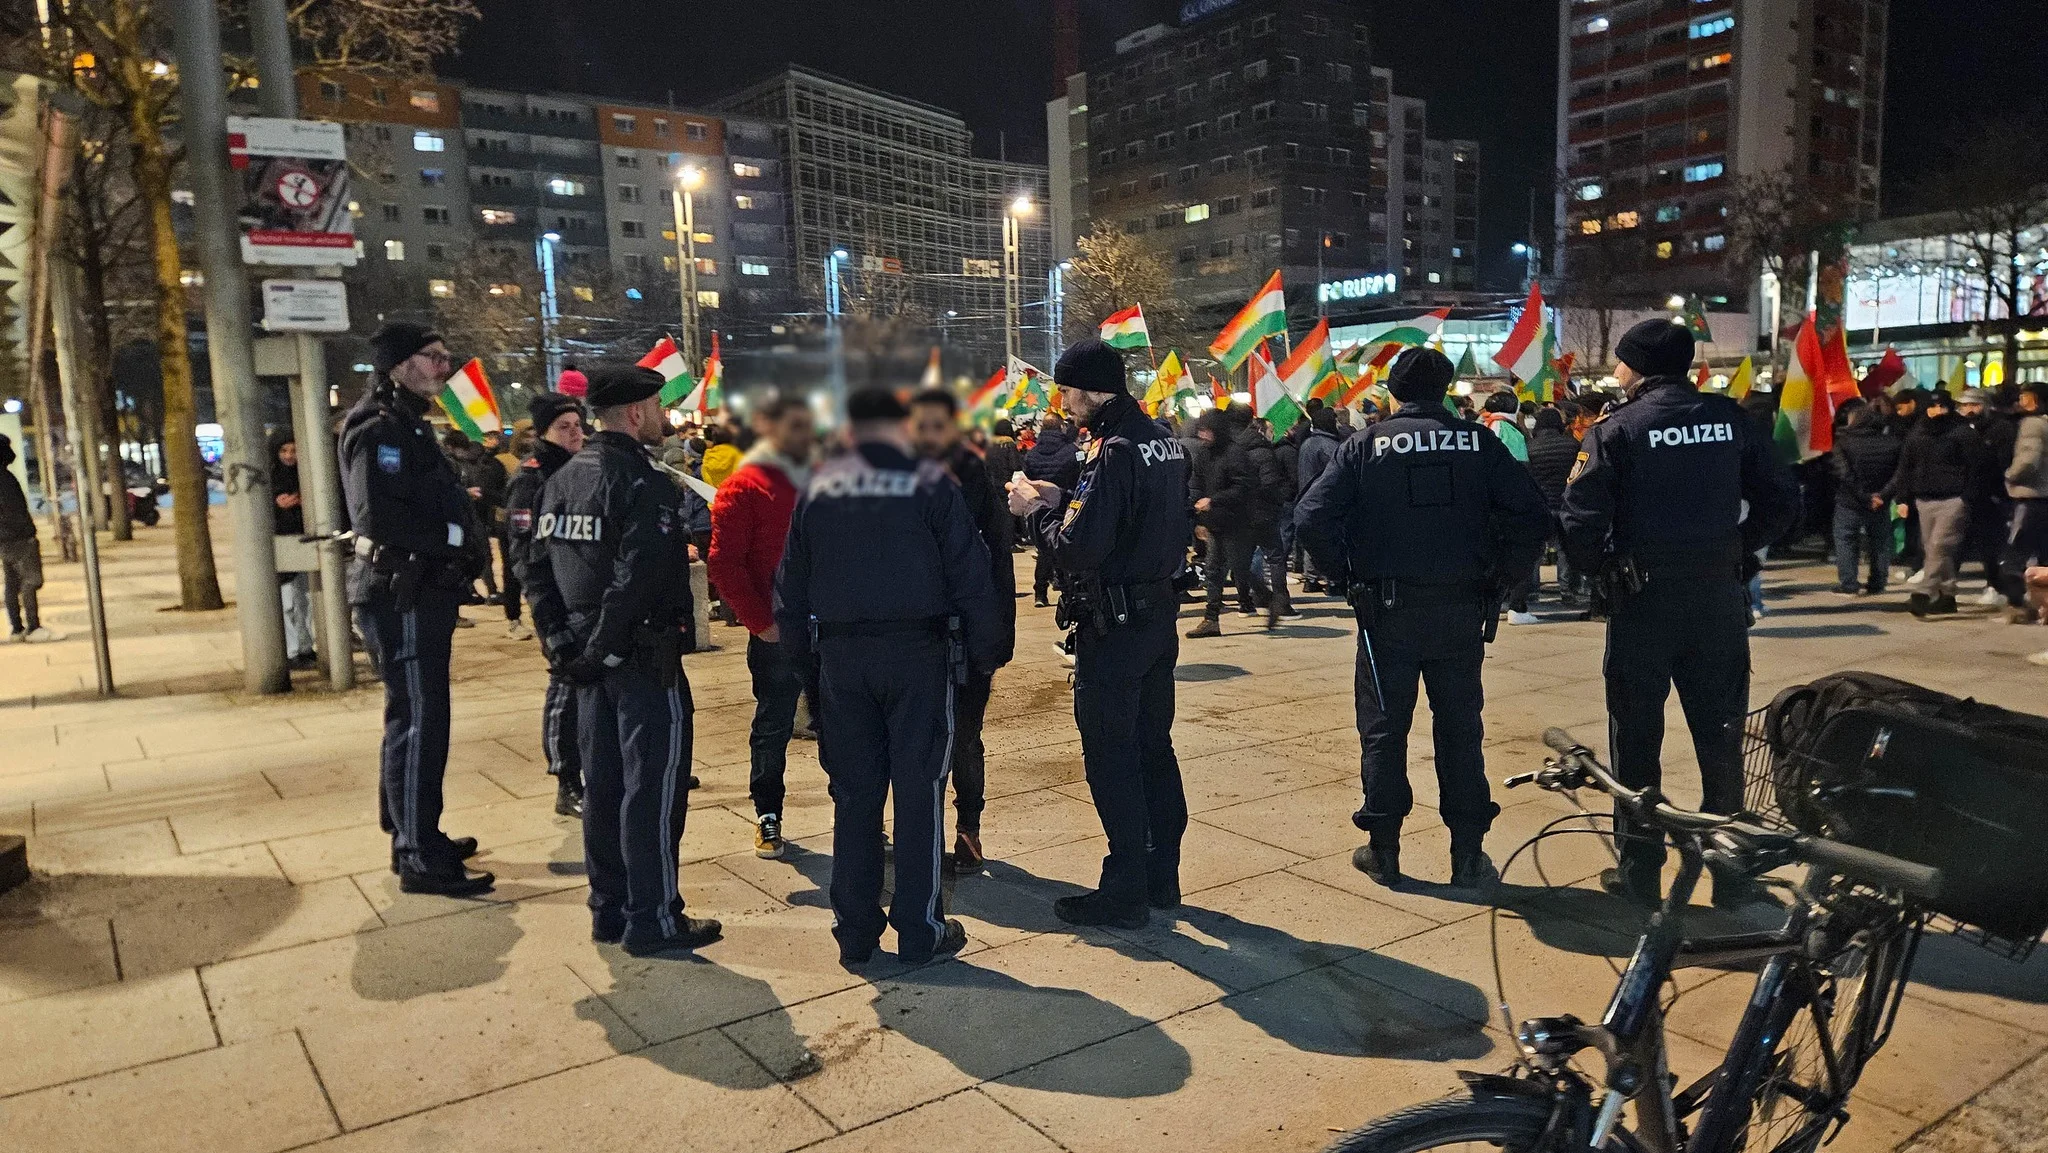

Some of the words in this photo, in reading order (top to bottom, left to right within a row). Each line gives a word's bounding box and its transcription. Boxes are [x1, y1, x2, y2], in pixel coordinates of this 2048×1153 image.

[1375, 430, 1479, 457] POLIZEI
[1648, 423, 1733, 448] POLIZEI
[1138, 437, 1185, 467] POLIZE
